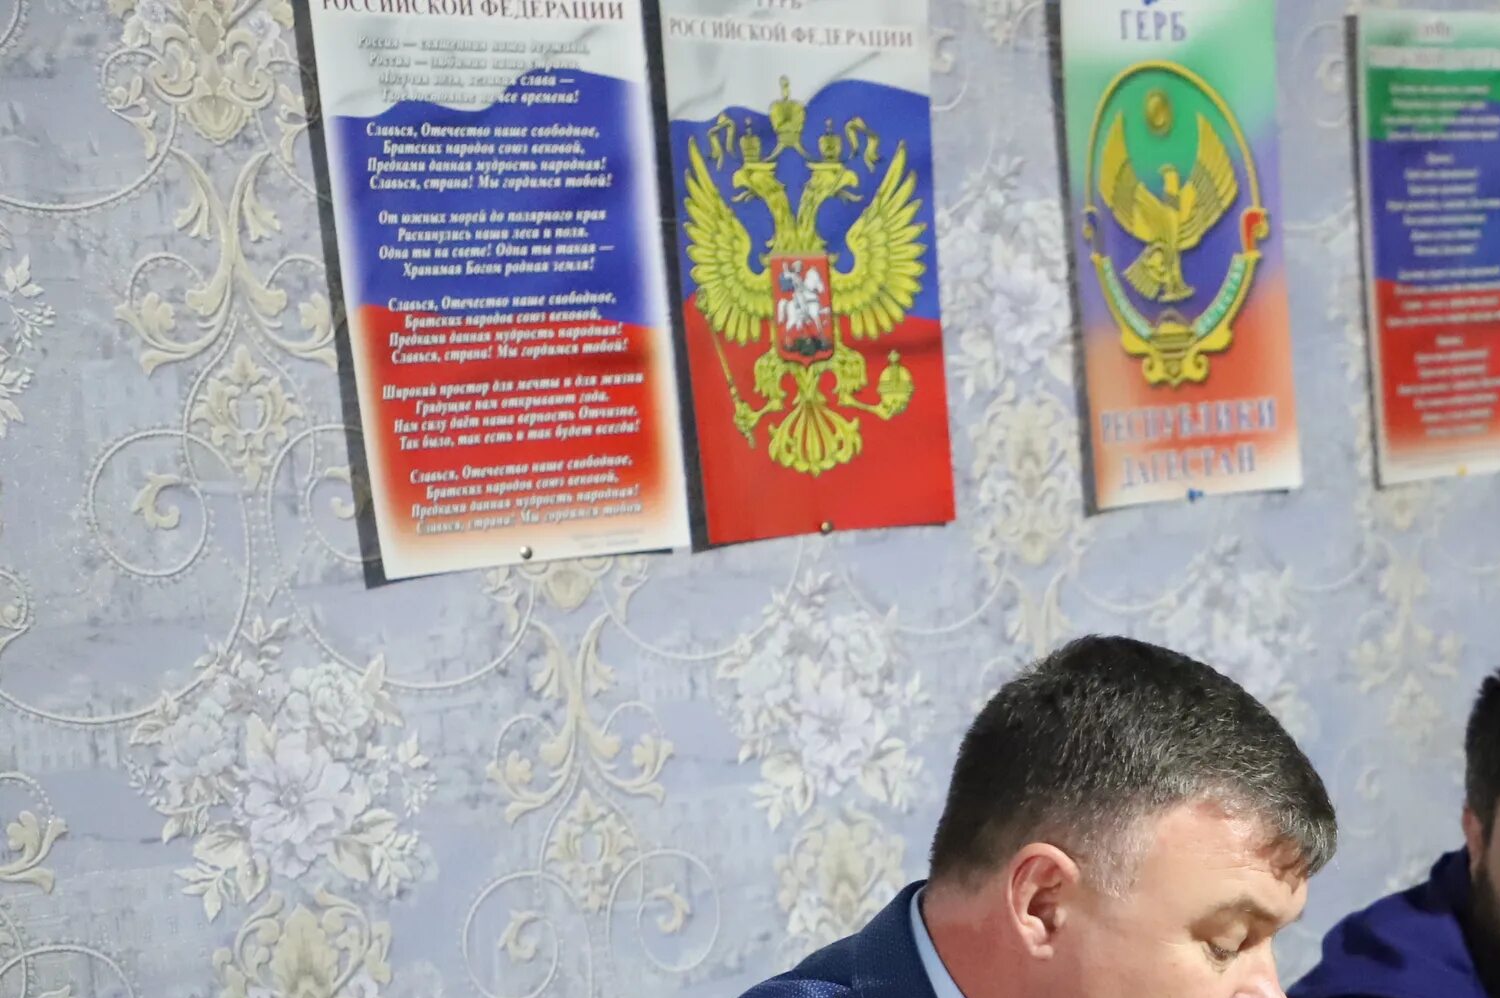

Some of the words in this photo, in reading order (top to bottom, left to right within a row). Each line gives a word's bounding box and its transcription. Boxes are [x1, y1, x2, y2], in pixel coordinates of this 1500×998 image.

[480, 0, 624, 20] ФЕДЕРАЦИИ
[670, 18, 786, 43] РОССИЙСКОЙ
[791, 26, 912, 48] ФЕДЕРАЦИИ
[1120, 9, 1187, 41] ГЕРБ
[520, 75, 556, 87] слава
[520, 89, 580, 107] времена!
[367, 123, 417, 137] Славься,
[421, 123, 490, 136] Отечество
[494, 127, 527, 137] наше
[383, 141, 441, 157] Братских
[446, 141, 494, 157] народов
[499, 144, 527, 153] союз
[368, 158, 425, 174] Предками
[429, 158, 471, 171] данная
[476, 158, 536, 174] мудрость
[540, 157, 607, 173] народная!
[370, 176, 420, 190] Славься,
[424, 175, 473, 191] страна!
[478, 175, 498, 188] Мы
[503, 175, 561, 191] гордимся
[565, 174, 613, 187] тобой!
[379, 211, 398, 224] От
[401, 213, 445, 223] южных
[449, 209, 486, 225] морей
[490, 209, 504, 222] до
[508, 211, 572, 224] полярного
[576, 210, 606, 223] края
[379, 246, 408, 259] Одна
[412, 249, 431, 258] ты
[434, 248, 448, 258] на
[452, 244, 492, 257] свете!
[496, 243, 527, 256] Одна
[532, 246, 552, 255] ты
[556, 245, 595, 255] такая
[403, 263, 462, 278] Хранимая
[466, 261, 501, 274] Богом
[505, 260, 549, 276] родная
[553, 258, 595, 272] земля!
[1102, 396, 1276, 442] РЕСПУБЛИКИ
[1122, 442, 1256, 488] ДАГЕСТАН
